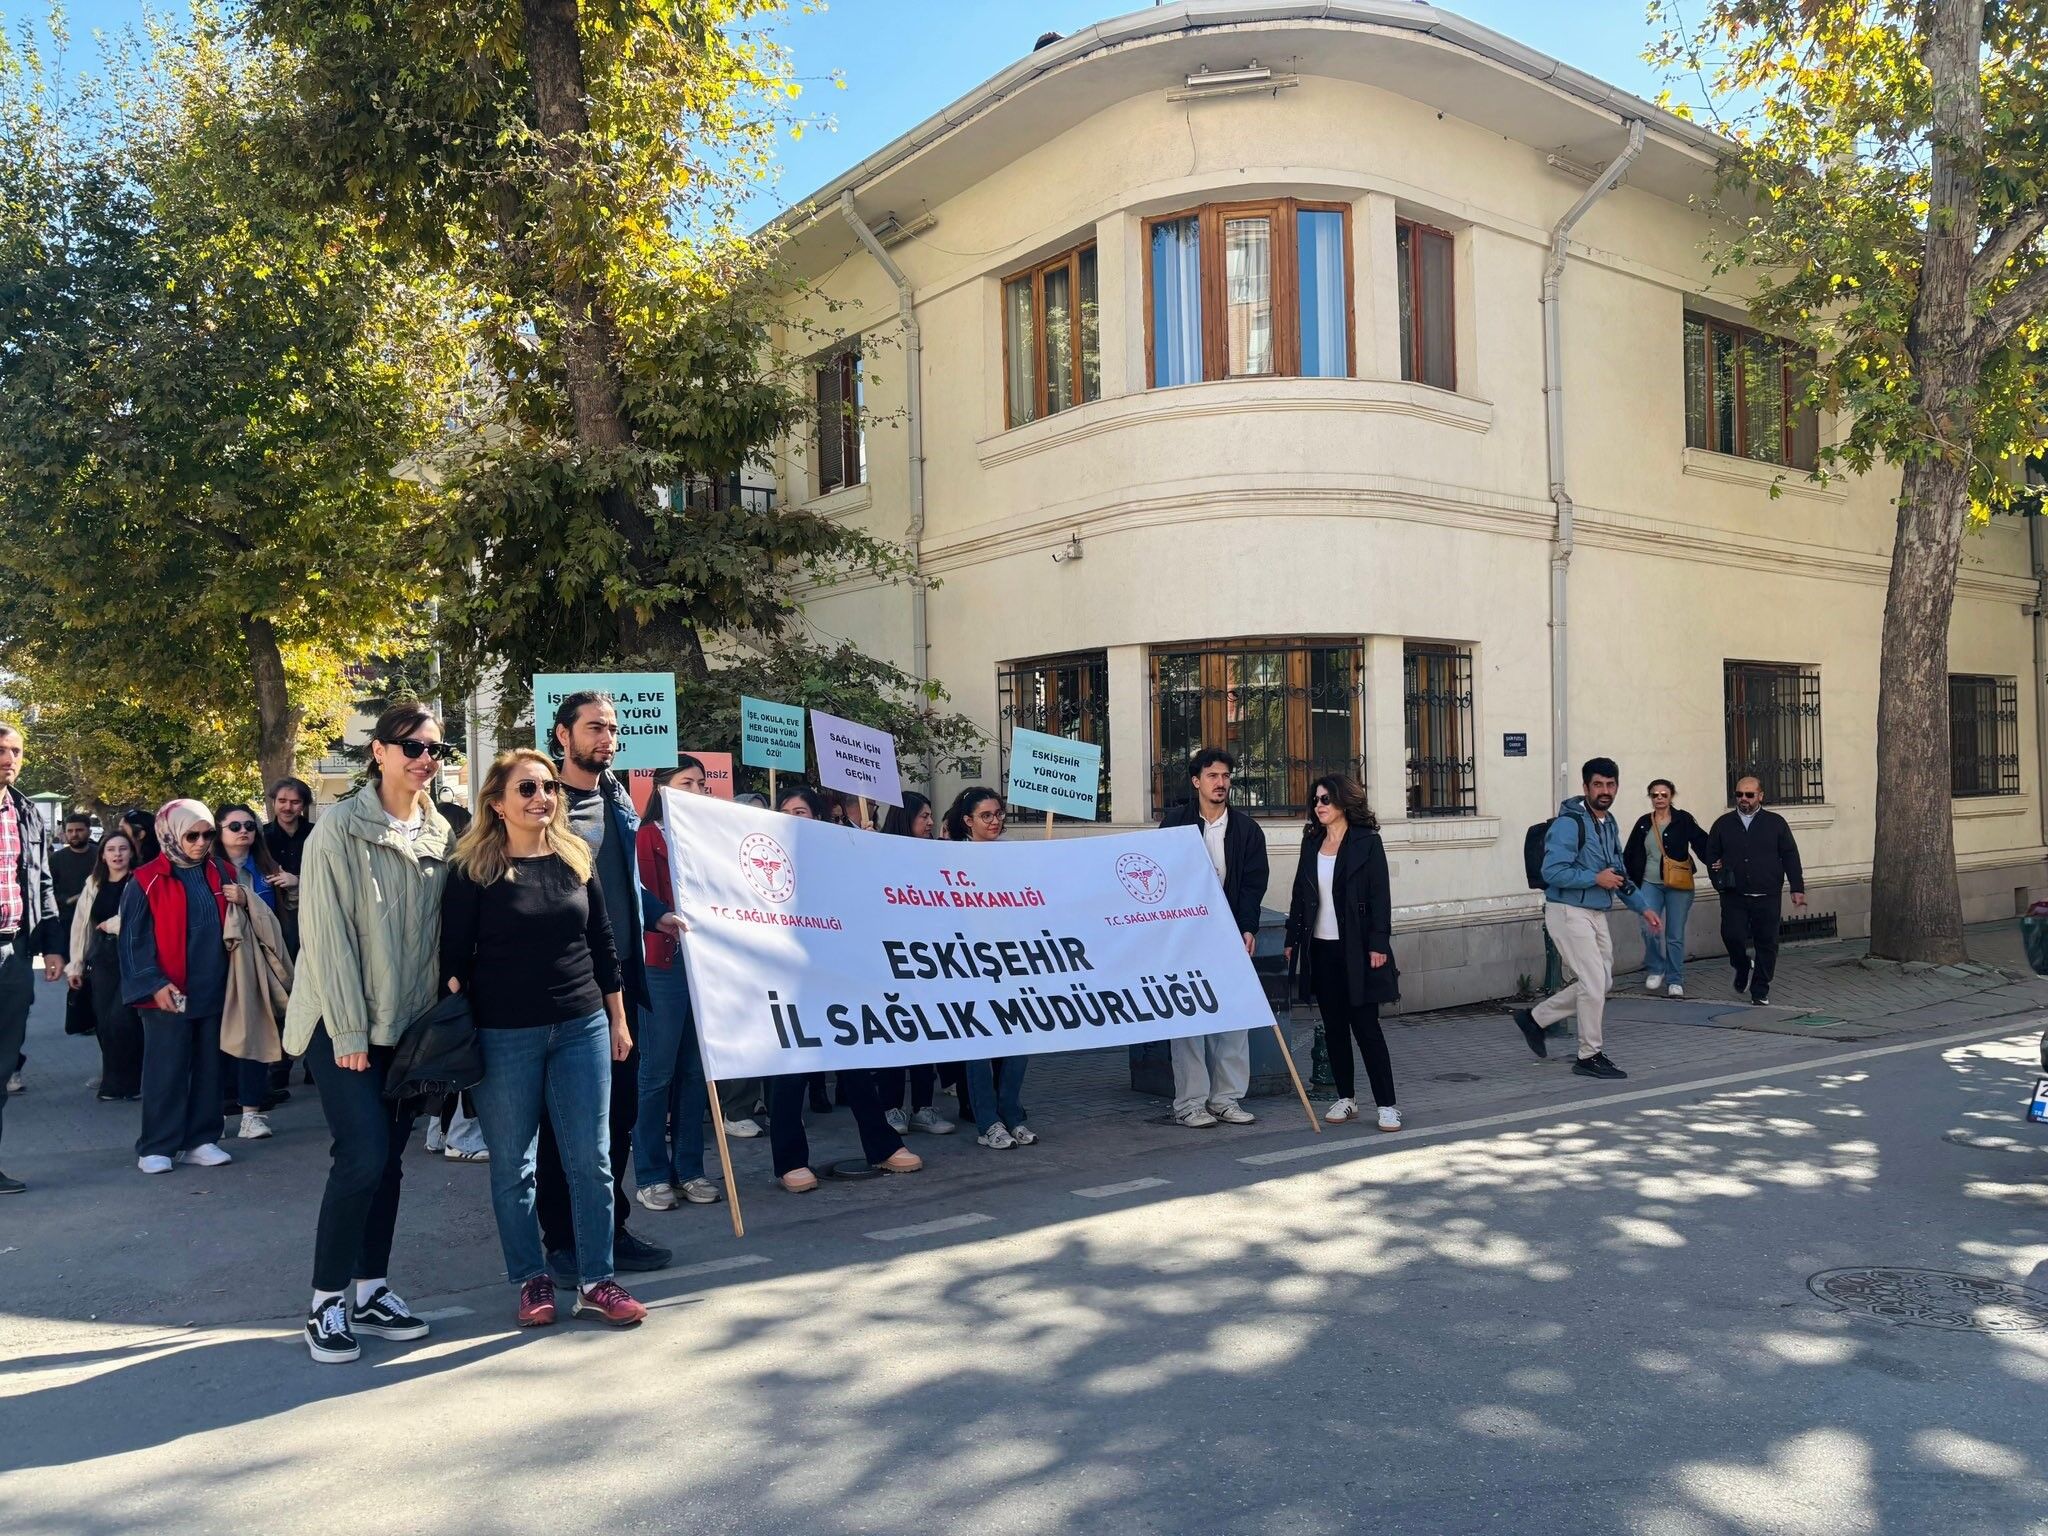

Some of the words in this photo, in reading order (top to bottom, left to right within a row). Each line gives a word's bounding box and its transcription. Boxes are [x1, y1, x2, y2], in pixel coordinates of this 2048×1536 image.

[637, 692, 664, 702] EVE
[622, 707, 661, 719] YÜRÜ
[760, 713, 785, 725] OKULA,
[786, 718, 800, 727] EVE
[749, 723, 762, 732] HER
[763, 725, 778, 734] GÜN
[780, 728, 798, 737] YÜRÜ
[746, 734, 769, 744] BUDUR
[770, 738, 801, 749] SAĞLIĞIN
[830, 732, 862, 749] SAĞLIK
[863, 741, 881, 755] İÇİN
[766, 748, 782, 757] ÖZÜ!
[835, 750, 881, 770] HAREKETE
[1032, 749, 1080, 767] ESKİŞEHİR
[845, 768, 872, 782] GEÇİN
[1033, 766, 1077, 783] YÜRÜYOR
[1013, 778, 1048, 793] YÜZLER
[1051, 787, 1093, 802] GÜLÜYOR
[940, 870, 976, 887] T.C.
[884, 884, 950, 907] SAĞLIK
[950, 886, 1046, 908] BAKANLIĞI
[711, 906, 735, 920] T.C.
[735, 908, 779, 926] SAĞLIK
[781, 914, 843, 931] BAKANLIĞI
[1104, 916, 1125, 927] T.C.
[1124, 911, 1160, 925] SAĞLIK
[1159, 904, 1209, 921] BAKANLIĞI
[882, 929, 1095, 984] ESKİŞEHİR
[768, 990, 823, 1049] İL
[826, 992, 993, 1046] SAĞLIK
[988, 970, 1219, 1036] MÜDÜRLÜĞÜ
